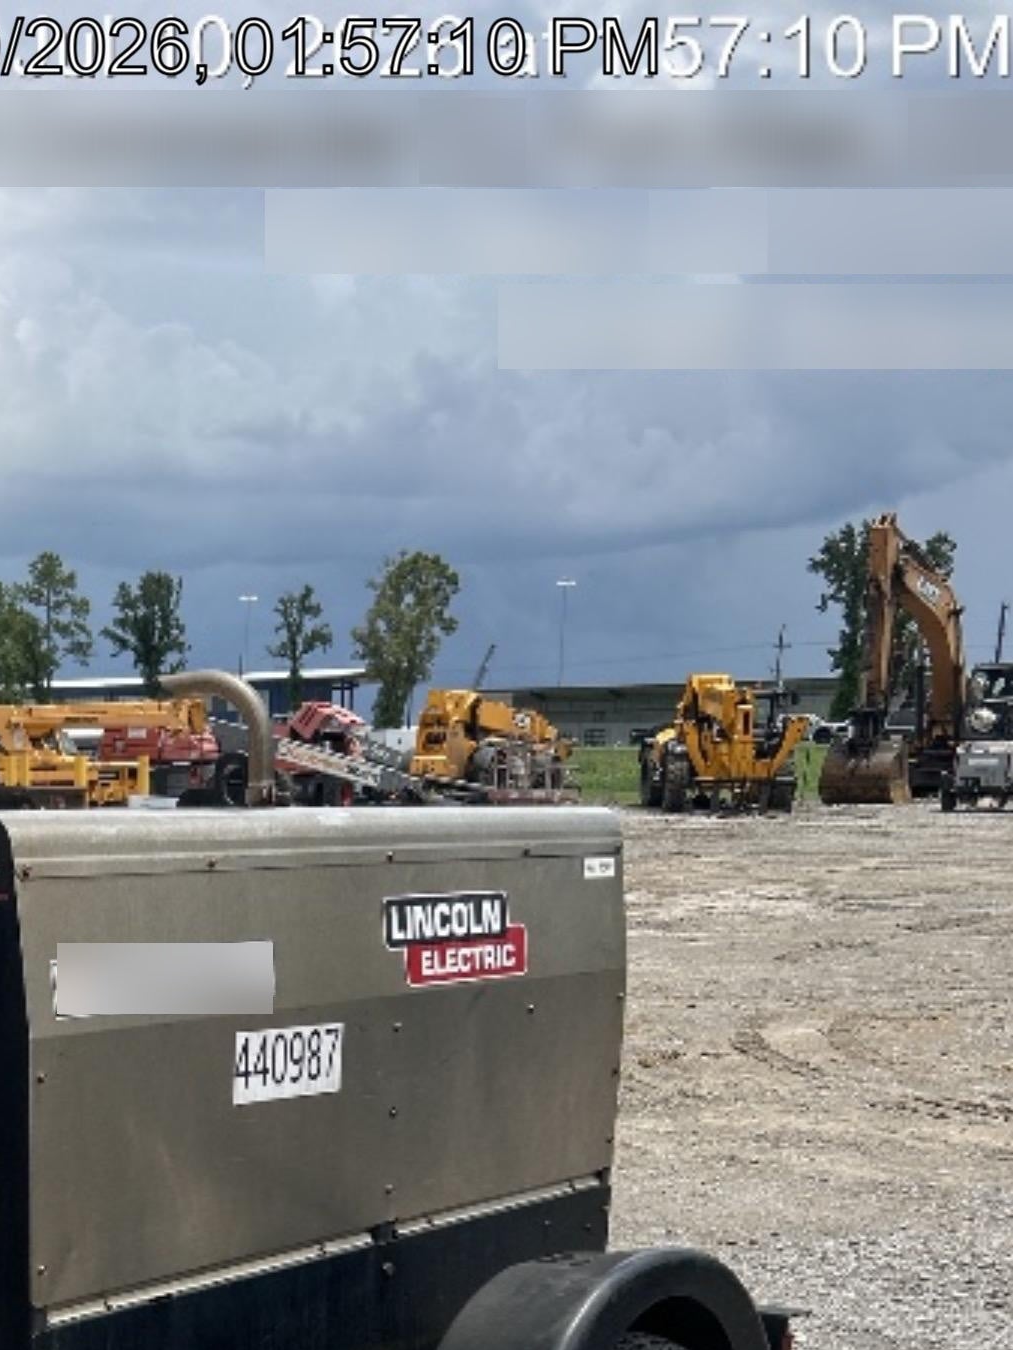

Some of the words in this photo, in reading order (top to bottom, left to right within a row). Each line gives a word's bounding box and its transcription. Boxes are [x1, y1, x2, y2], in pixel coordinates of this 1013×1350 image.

[390, 898, 502, 941] LINCOLN
[421, 943, 517, 977] ELECTRIC
[235, 1028, 339, 1089] 440987
